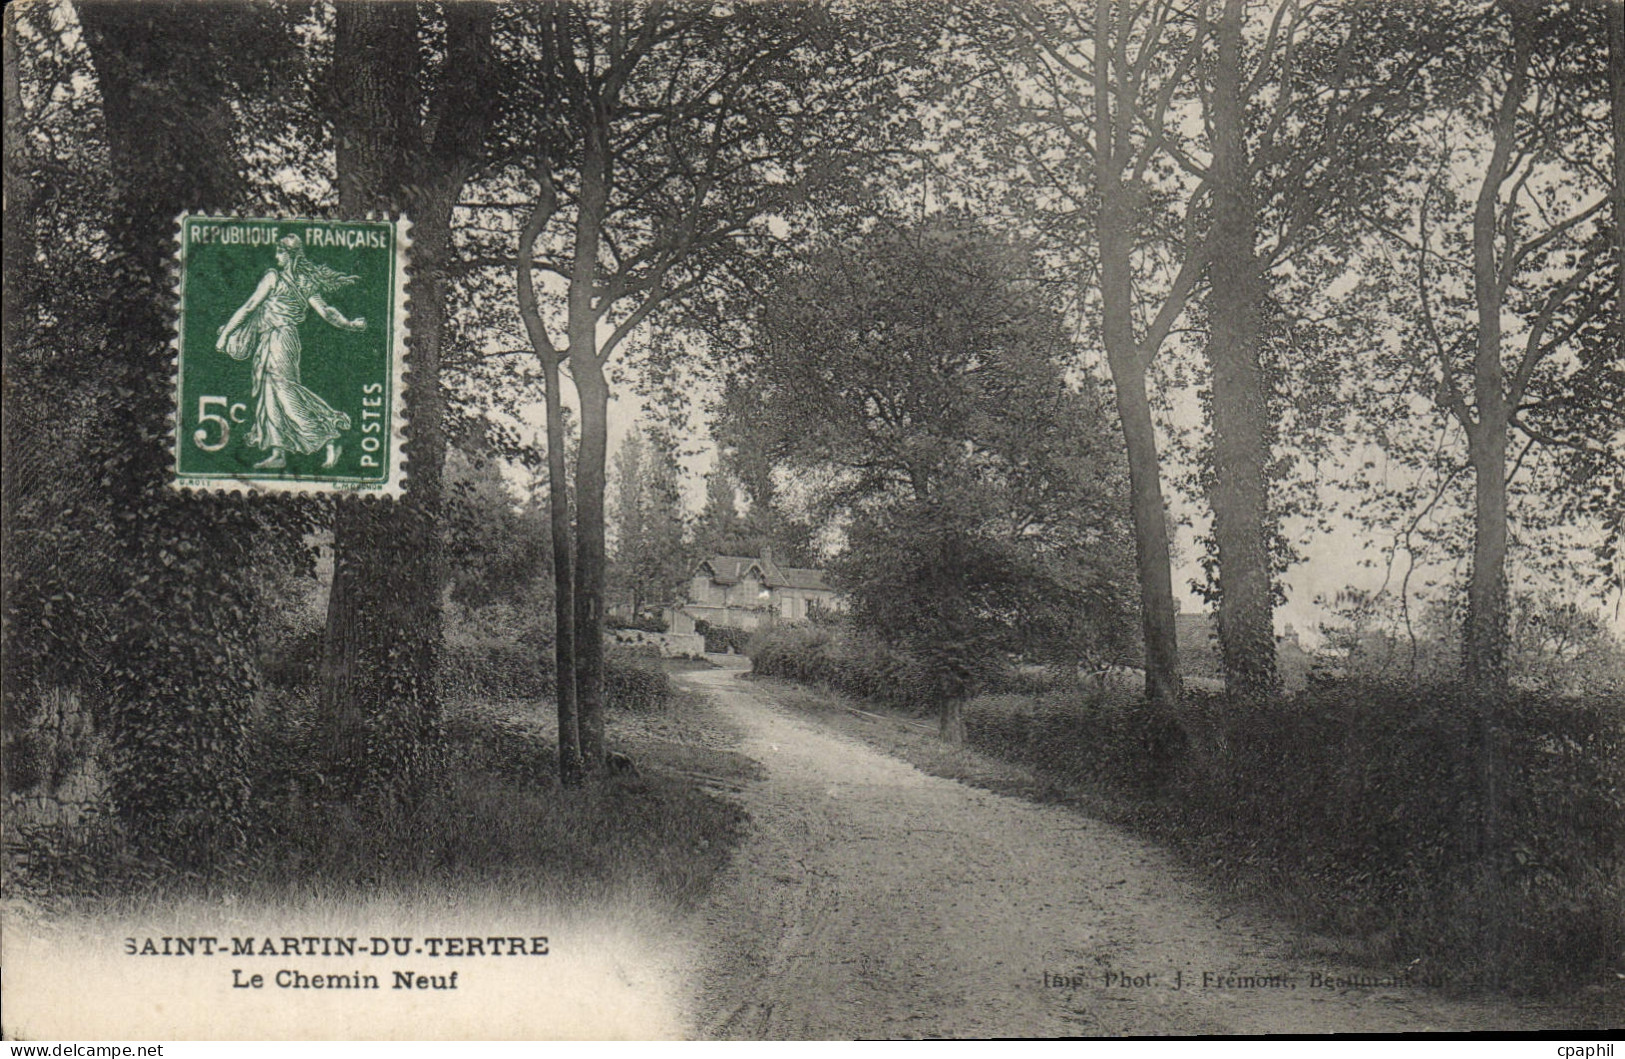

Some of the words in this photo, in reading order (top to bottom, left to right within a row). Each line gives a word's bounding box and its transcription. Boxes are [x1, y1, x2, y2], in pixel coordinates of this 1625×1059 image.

[305, 227, 387, 250] FRANÇAISE
[360, 382, 382, 468] POSTES
[124, 936, 549, 957] SAINT-MARTIN-DU-TERTRE
[232, 969, 264, 989] Le
[275, 968, 379, 990] Chemin
[392, 969, 459, 990] Neuf
